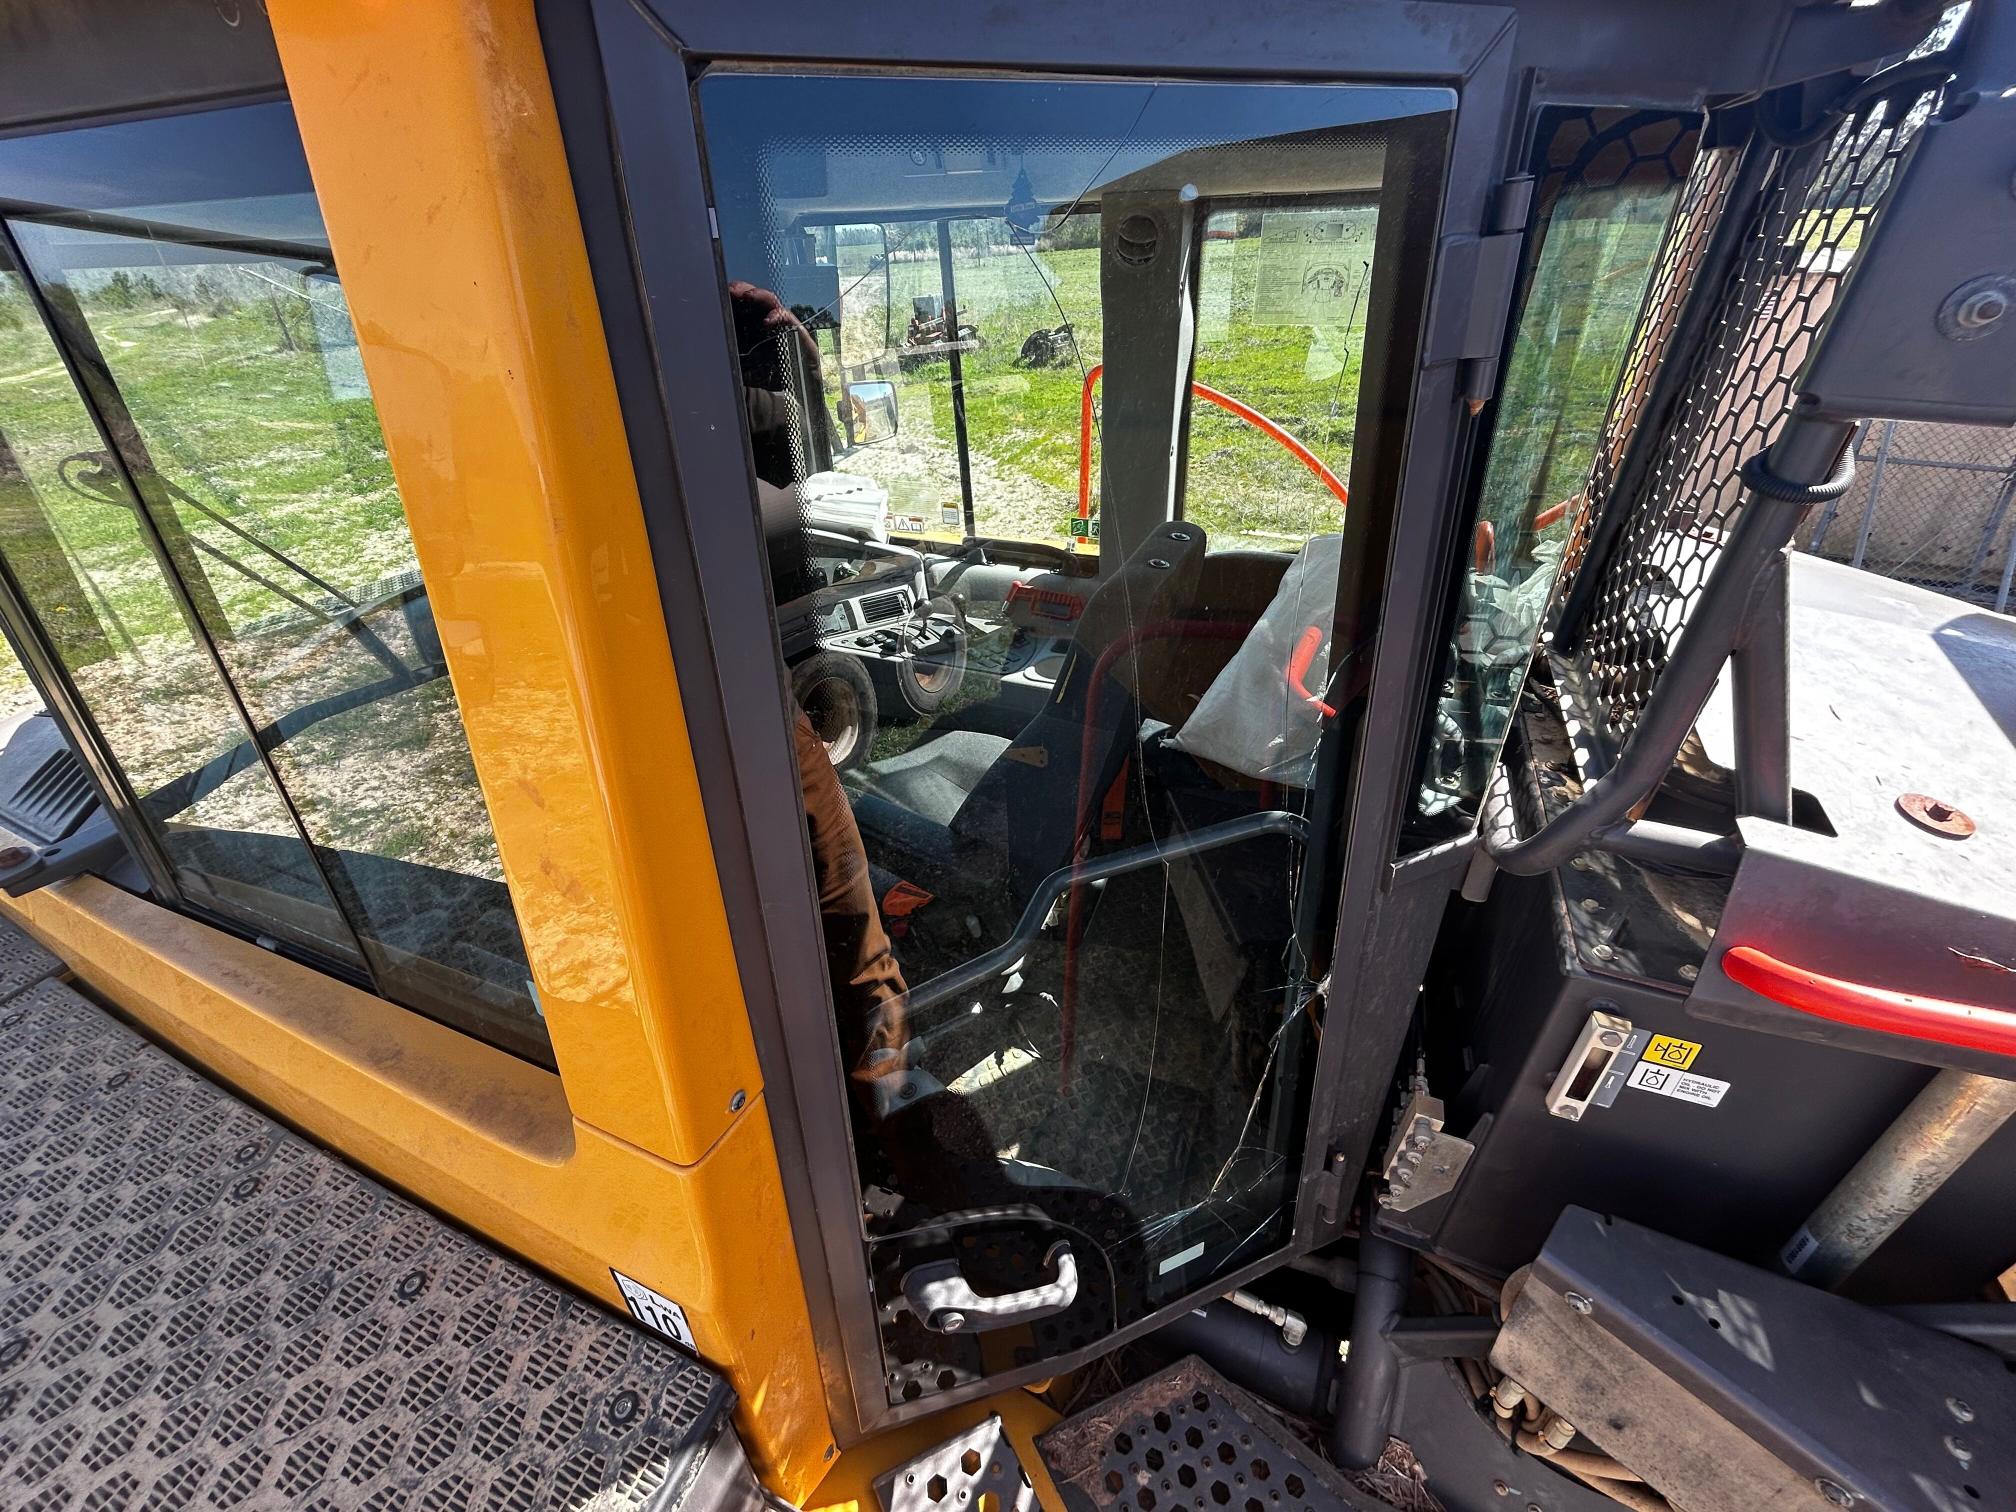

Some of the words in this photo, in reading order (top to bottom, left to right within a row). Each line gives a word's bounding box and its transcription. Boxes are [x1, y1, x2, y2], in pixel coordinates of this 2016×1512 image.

[1683, 1078, 1720, 1089] HYDRAULIC
[1677, 1089, 1700, 1097] ENGINE
[628, 1296, 682, 1341] 110
